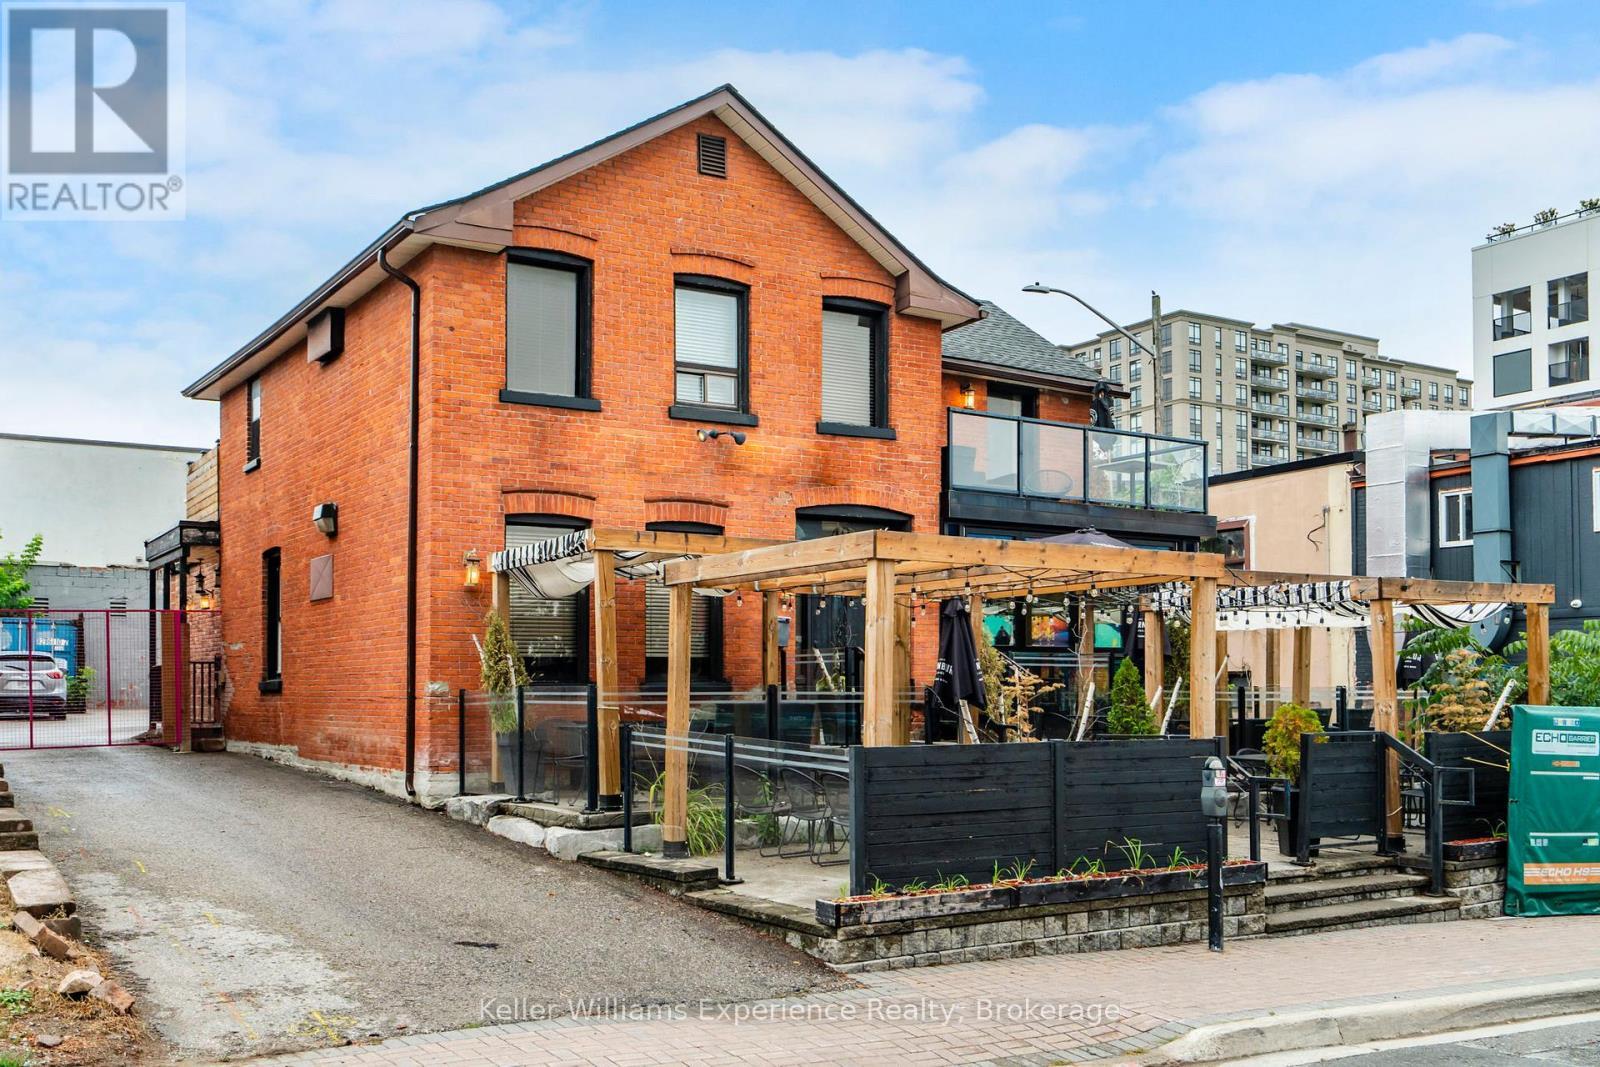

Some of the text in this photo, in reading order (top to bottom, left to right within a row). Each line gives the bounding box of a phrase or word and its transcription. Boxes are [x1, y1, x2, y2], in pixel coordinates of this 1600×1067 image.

[1535, 732, 1596, 744] ECHO BARRIER
[1540, 867, 1572, 877] ECHO
